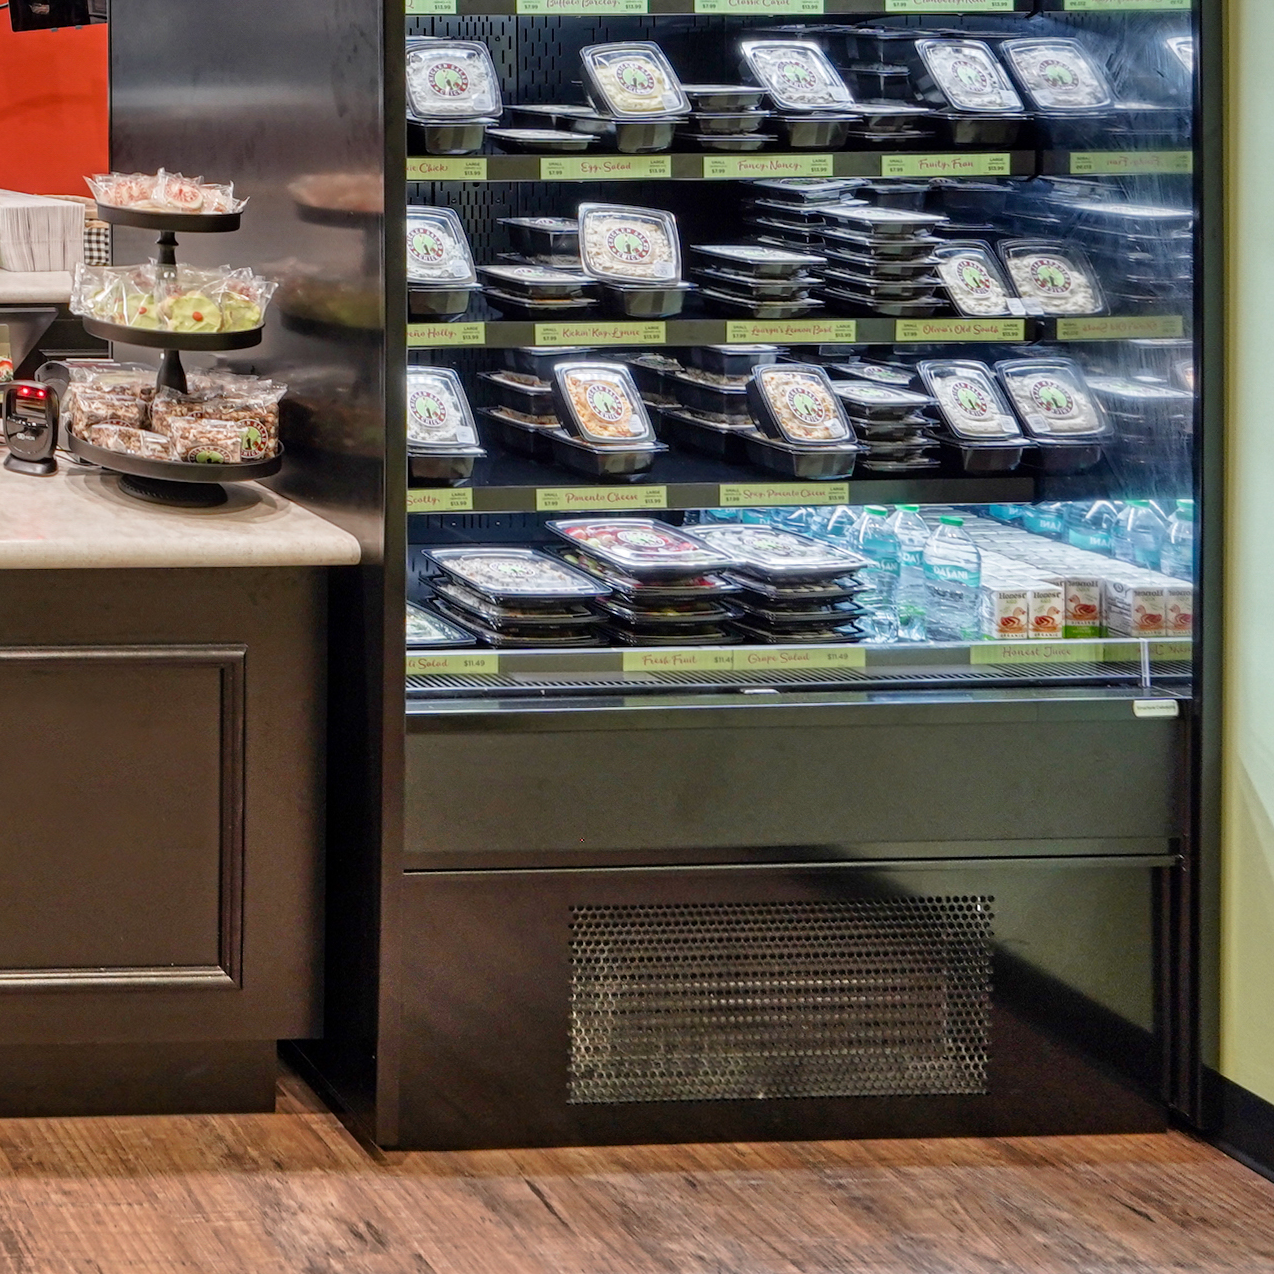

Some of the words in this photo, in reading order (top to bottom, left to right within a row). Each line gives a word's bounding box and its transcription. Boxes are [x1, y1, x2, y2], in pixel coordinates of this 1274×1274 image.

[419, 163, 448, 173] Chick
[581, 162, 601, 173] Egg
[603, 162, 631, 172] Salad
[737, 160, 768, 171] Fancy
[770, 160, 802, 171] Nancy
[918, 159, 950, 170] Fruity
[951, 158, 974, 168] Fran
[428, 329, 457, 339] Holly
[592, 328, 611, 339] Kay
[612, 329, 640, 338] Lynne
[954, 325, 971, 334] Old
[973, 325, 999, 334] South
[607, 491, 638, 502] Cheese
[933, 564, 969, 580] DASANI
[1002, 646, 1040, 658] Honest
[1042, 646, 1072, 658] Juice
[642, 655, 669, 666] Fresh
[672, 655, 698, 665] Fruit
[747, 653, 778, 667] Grape
[781, 652, 810, 662] Salad
[827, 653, 849, 661] $11.49
